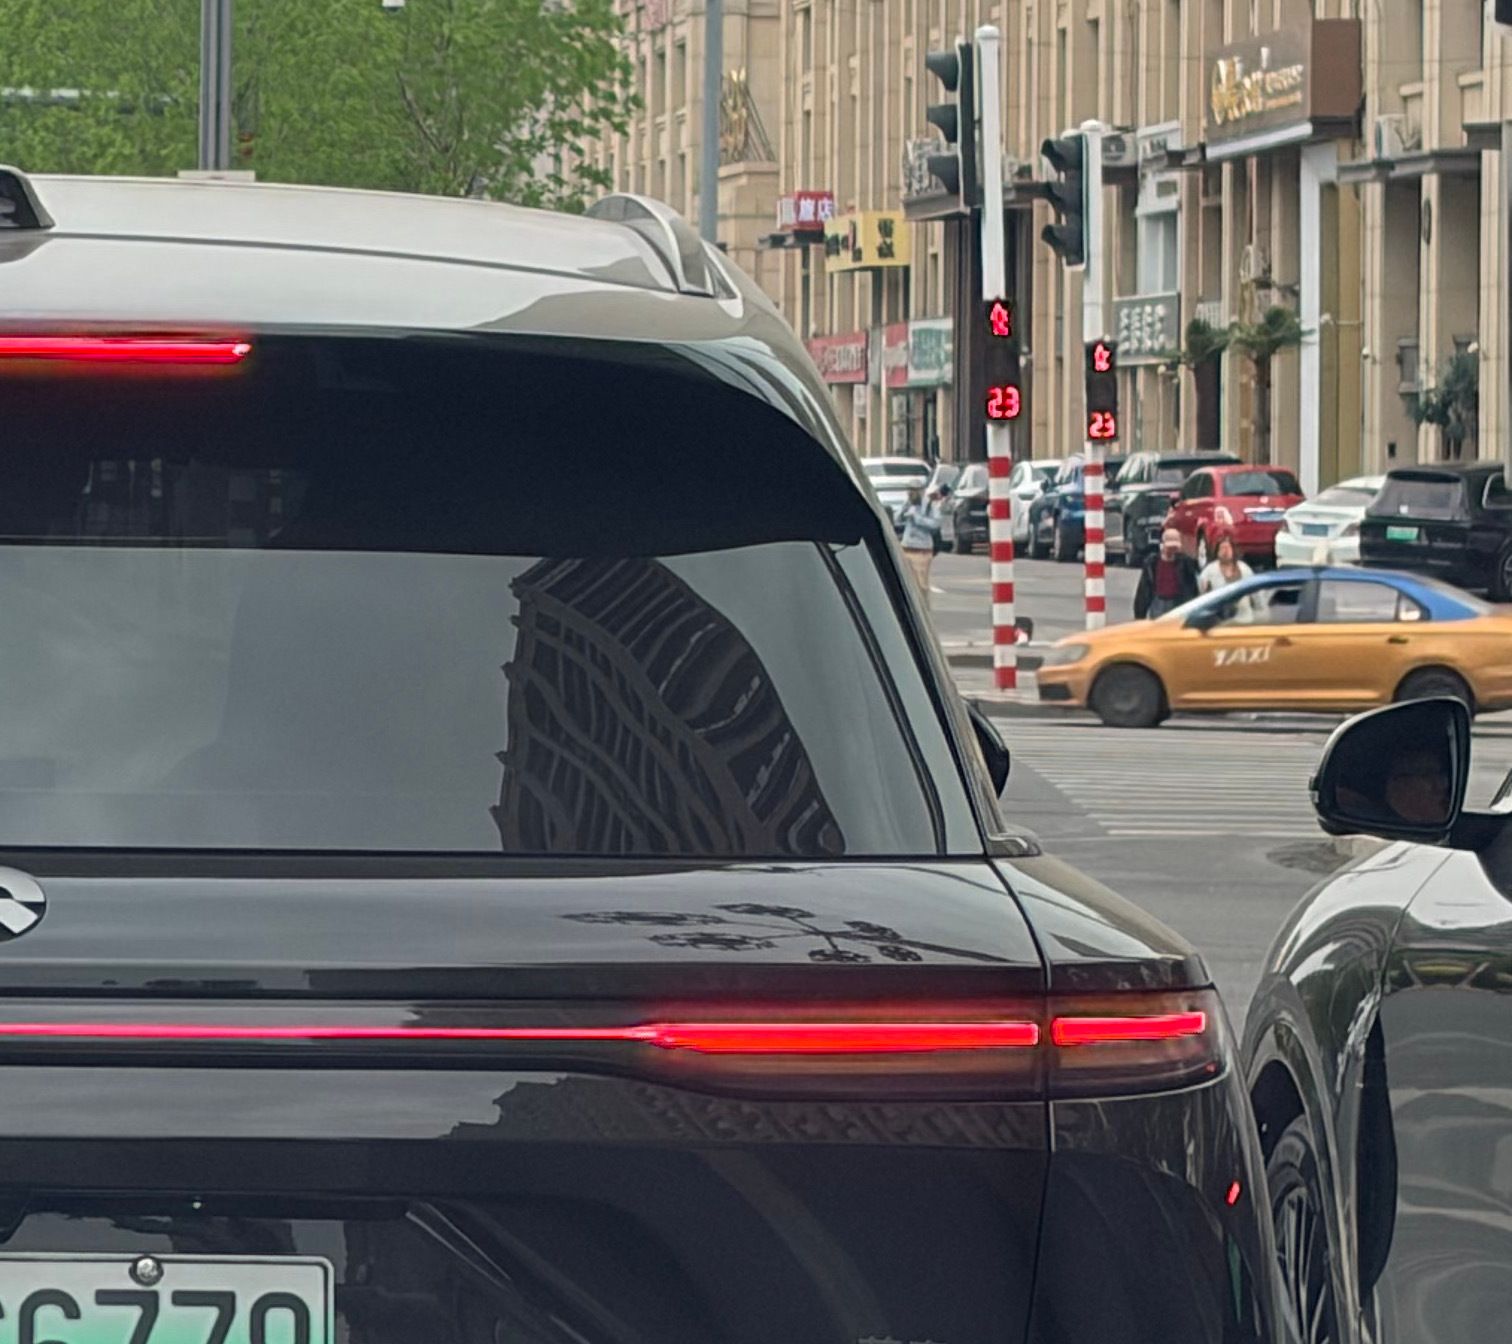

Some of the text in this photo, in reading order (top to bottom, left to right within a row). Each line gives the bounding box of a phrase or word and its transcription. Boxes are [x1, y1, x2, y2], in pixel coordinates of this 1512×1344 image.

[987, 385, 1020, 418] 23
[1089, 411, 1115, 438] 23
[1213, 646, 1271, 667] TAXI
